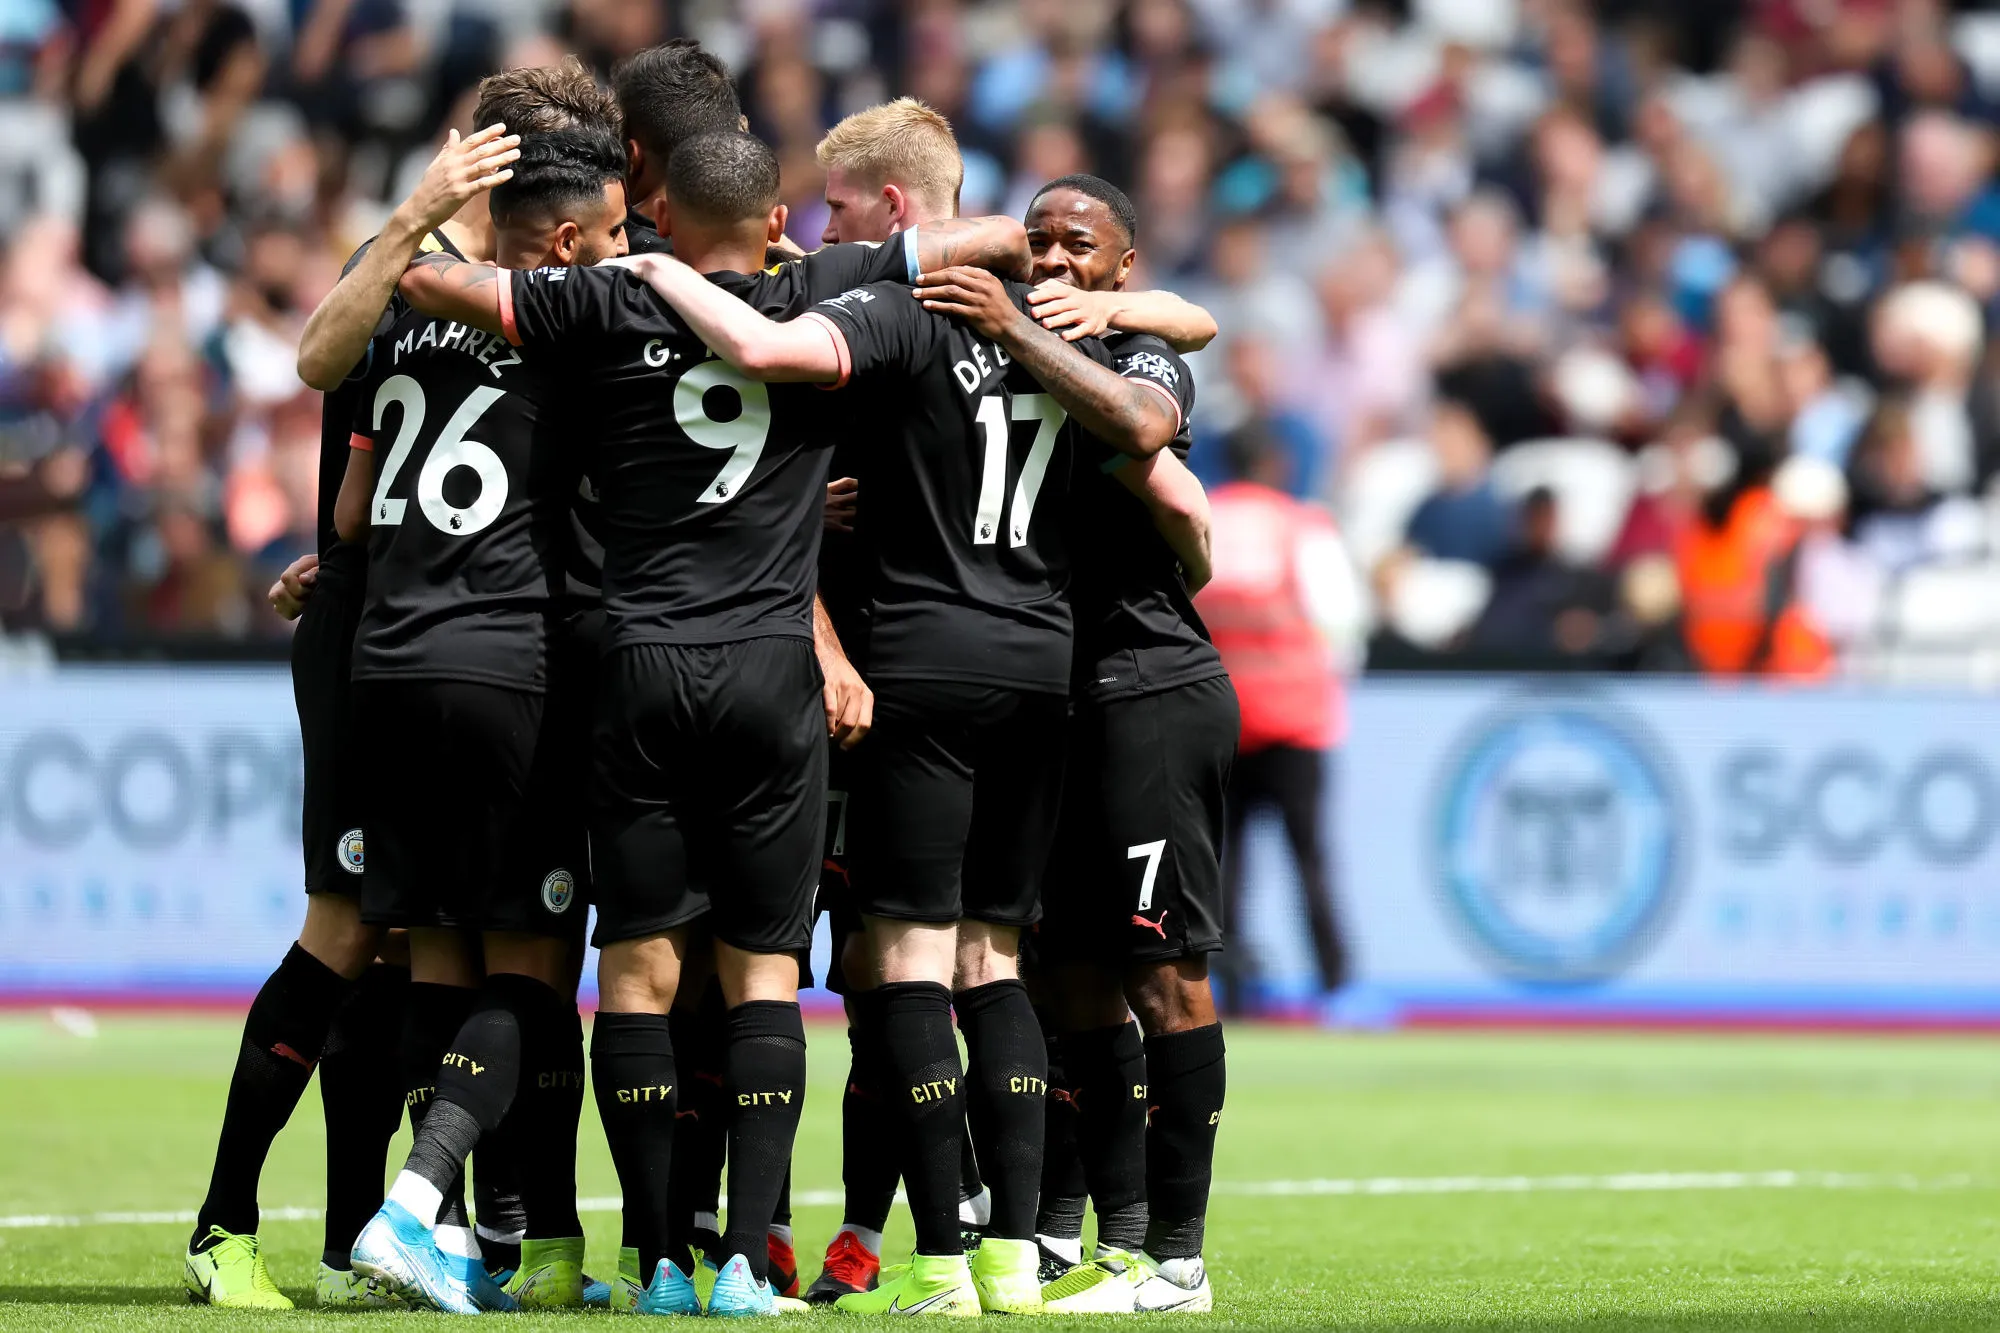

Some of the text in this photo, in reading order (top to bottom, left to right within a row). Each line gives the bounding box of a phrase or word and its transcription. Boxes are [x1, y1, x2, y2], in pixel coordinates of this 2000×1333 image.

[394, 321, 523, 378] MAHREZ
[643, 339, 681, 367] G.
[953, 343, 992, 394] DE
[673, 360, 771, 503] 9
[371, 375, 509, 535] 26
[974, 393, 1067, 548] 17
[0, 727, 304, 850] COP
[1127, 839, 1166, 911] 7
[442, 1053, 485, 1076] CITY
[617, 1085, 672, 1103] CITY
[738, 1090, 792, 1106] CITY
[911, 1078, 957, 1104] CITY
[1010, 1076, 1047, 1096] CITY
[1133, 1085, 1148, 1099] CI
